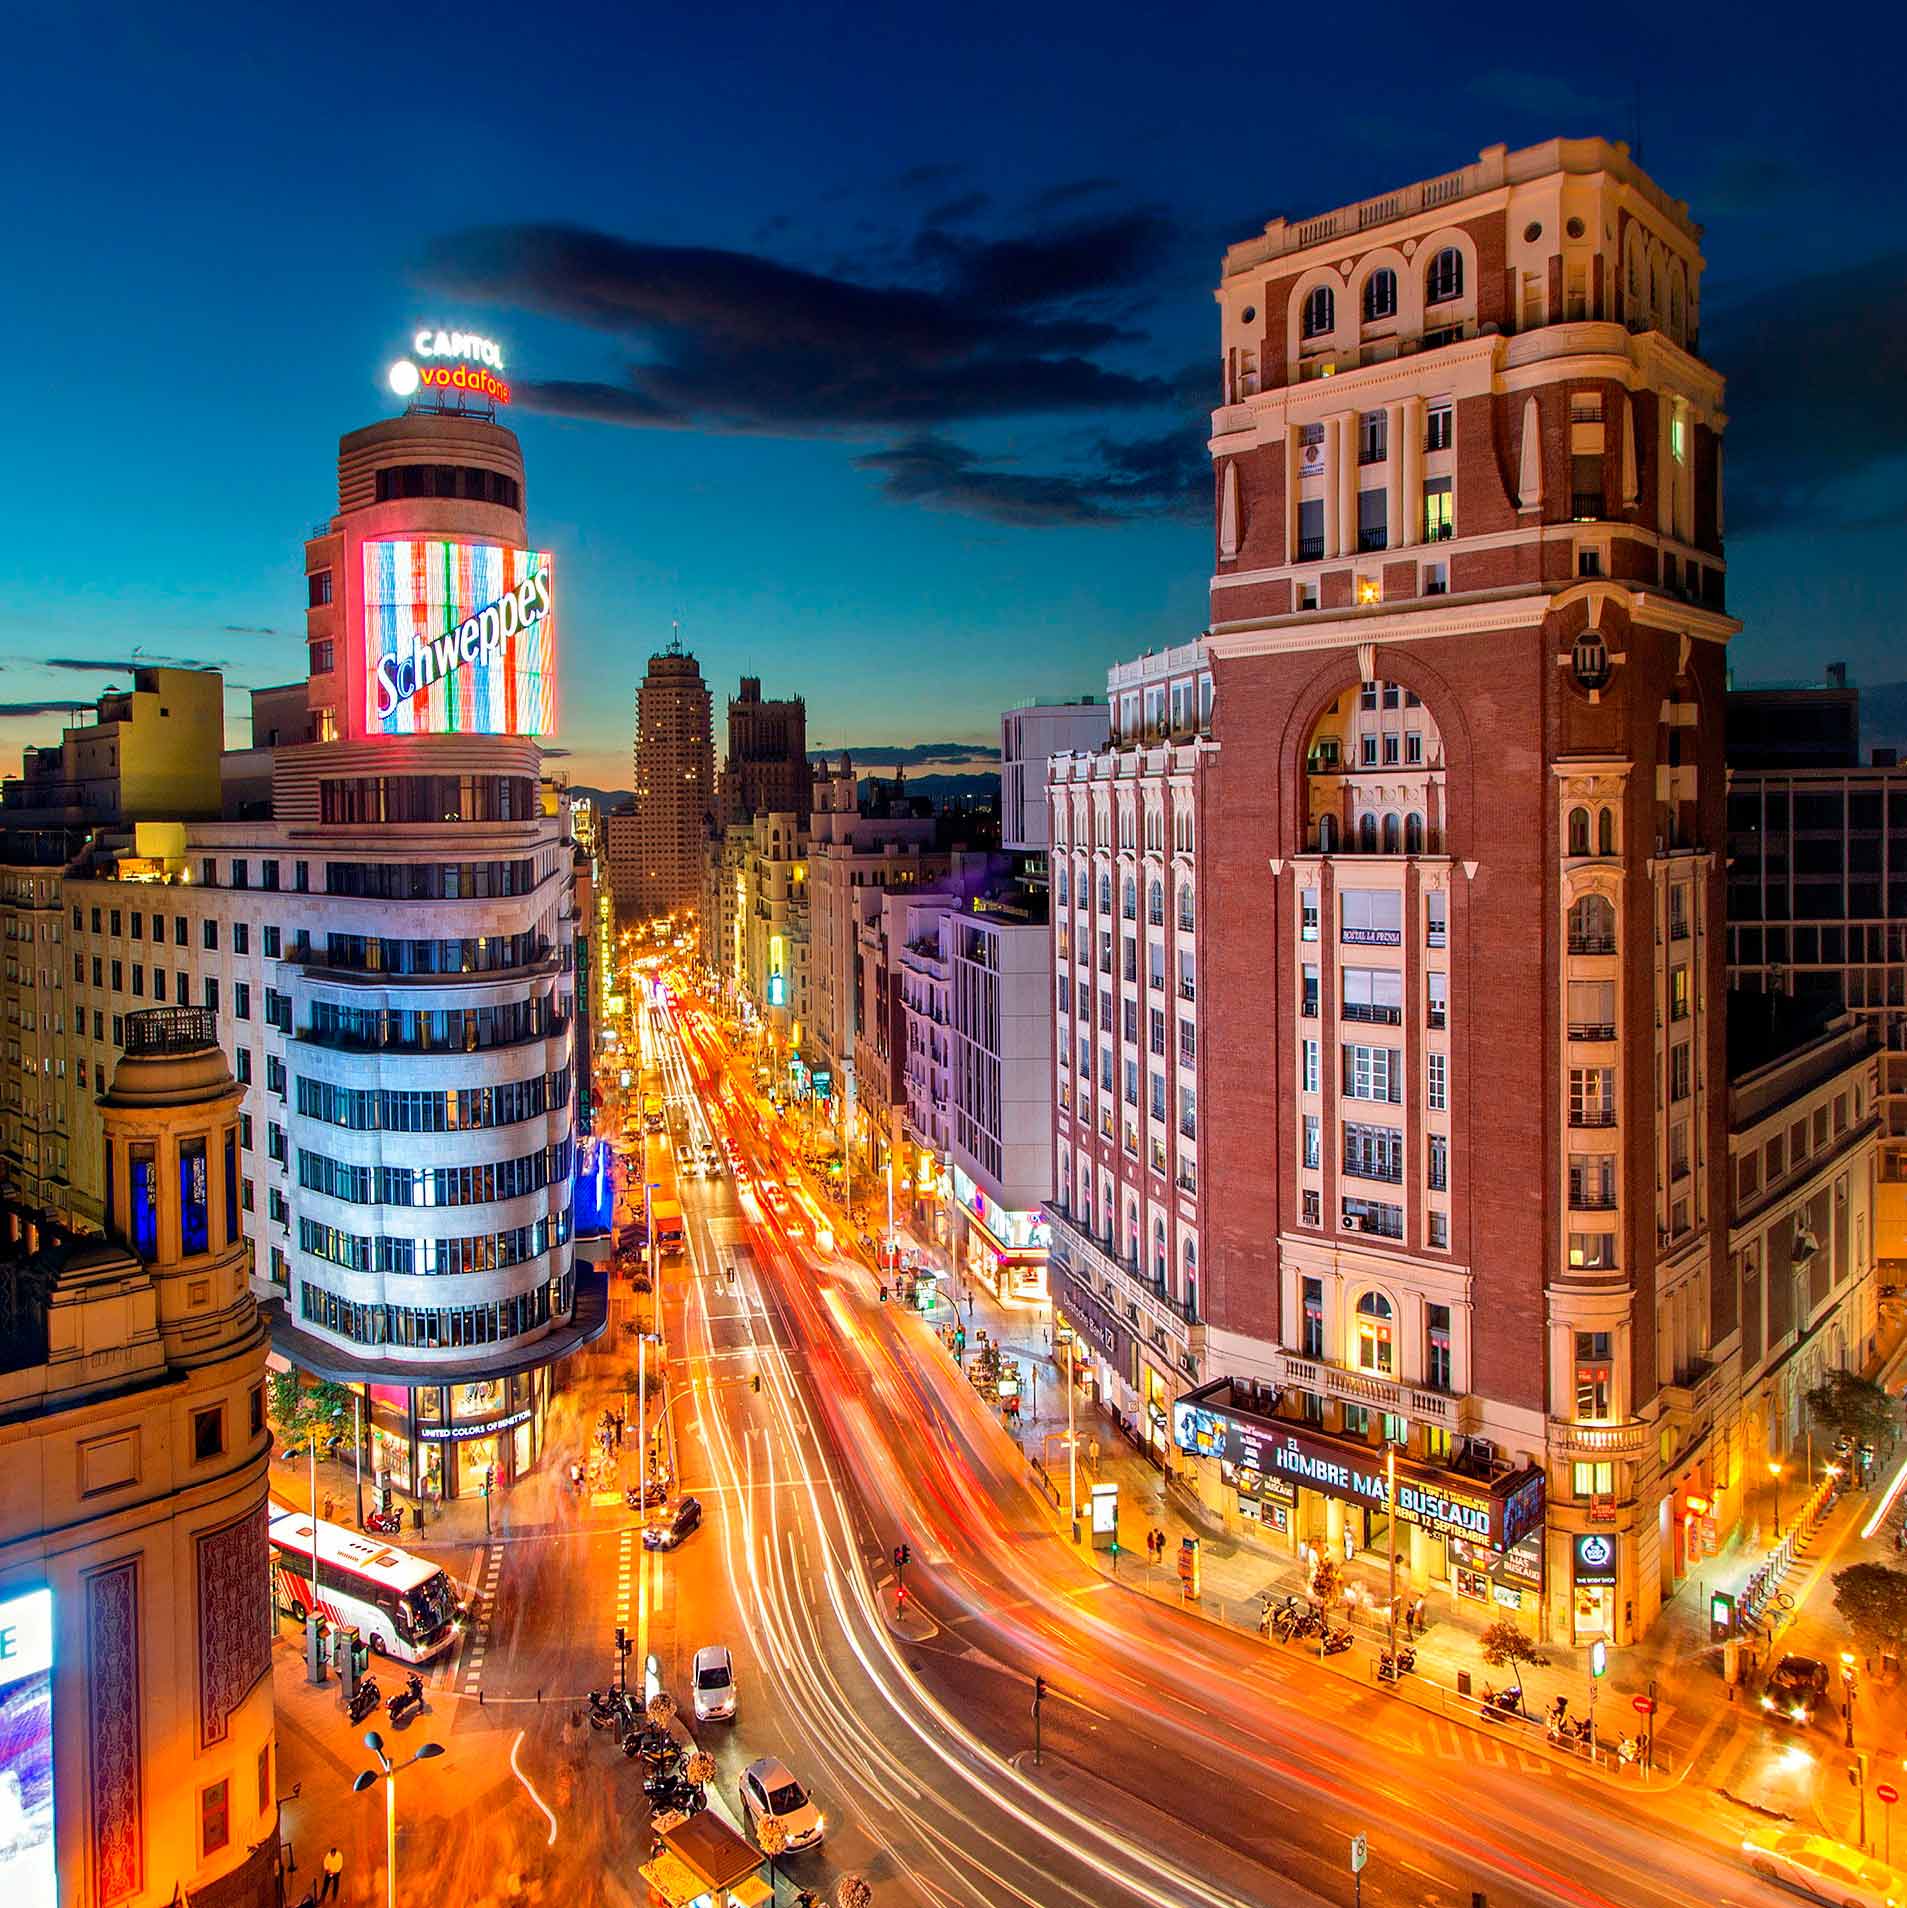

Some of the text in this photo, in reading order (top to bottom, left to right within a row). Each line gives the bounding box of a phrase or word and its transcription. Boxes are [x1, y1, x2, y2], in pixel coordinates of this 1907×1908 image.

[415, 330, 504, 371] CAPITOL
[419, 363, 511, 404] vodafone
[377, 566, 550, 720] Schweppes
[578, 939, 590, 1131] HOTEL REX
[421, 1409, 532, 1438] UNITED COLORS OF BENETTON
[1287, 1436, 1300, 1452] EL
[1276, 1447, 1349, 1489] HOMBRE
[1399, 1486, 1490, 1535] BUSCADO
[1433, 1518, 1490, 1547] SEPTIEMBRE
